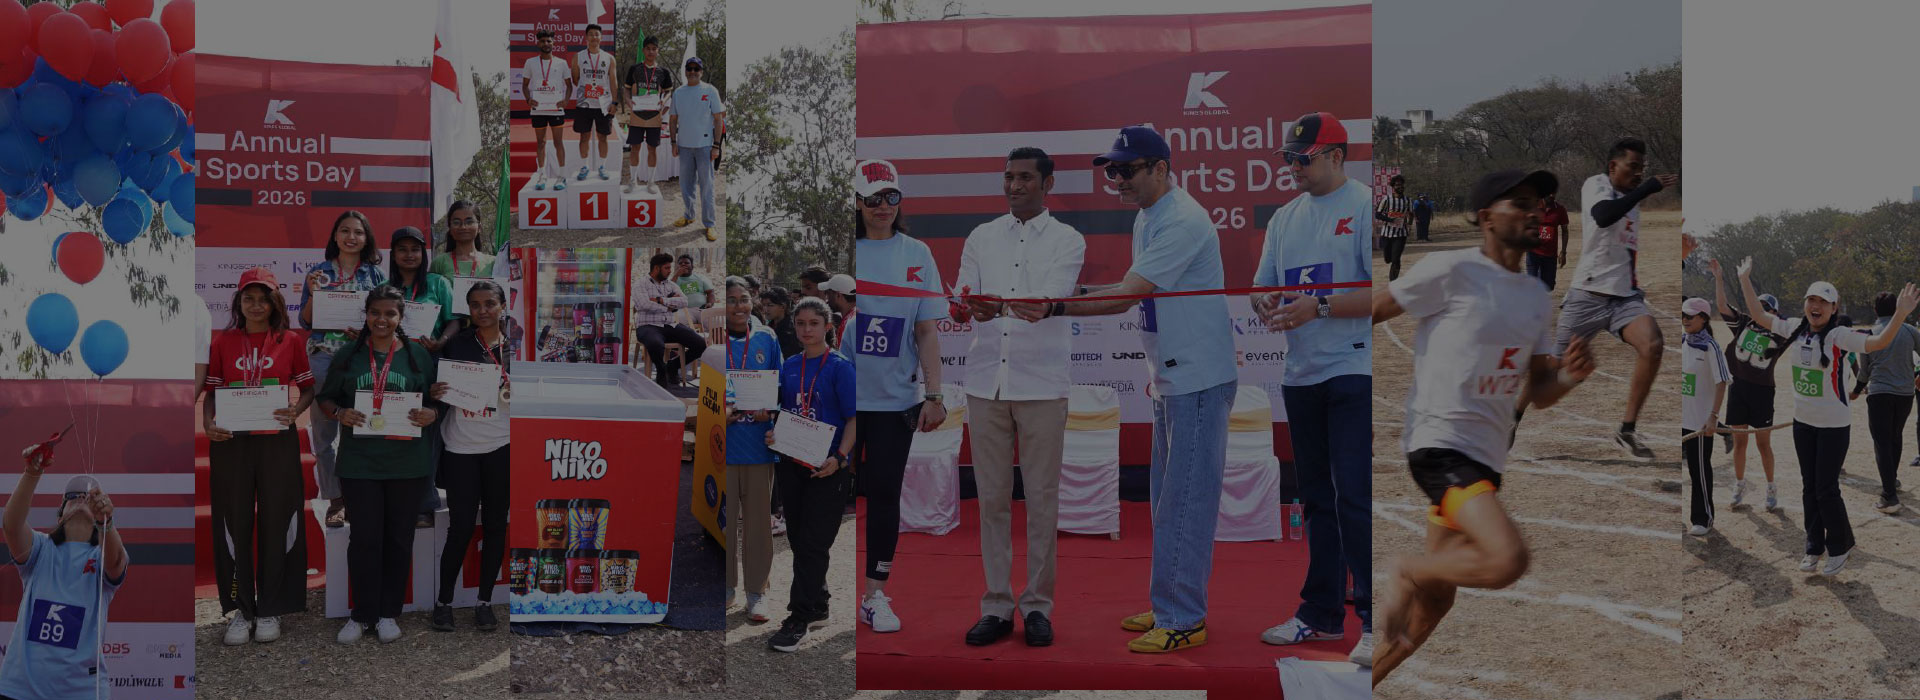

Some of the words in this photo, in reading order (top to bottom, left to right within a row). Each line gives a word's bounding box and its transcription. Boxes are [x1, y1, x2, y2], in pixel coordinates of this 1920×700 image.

[535, 22, 573, 31] Annual
[564, 33, 584, 44] Day
[230, 130, 325, 154] Annual
[1144, 117, 1273, 151] nnual
[206, 157, 300, 186] Sports
[306, 160, 355, 189] Day
[1247, 159, 1298, 191] Da
[257, 190, 306, 206] 2026
[586, 193, 599, 219] 1
[534, 199, 552, 224] 2
[634, 201, 651, 225] 3
[1213, 207, 1246, 229] 26
[861, 335, 889, 353] B9
[1745, 341, 1764, 354] G29
[1795, 381, 1818, 395] G28
[38, 622, 65, 643] B9
[159, 652, 182, 660] MEDIA
